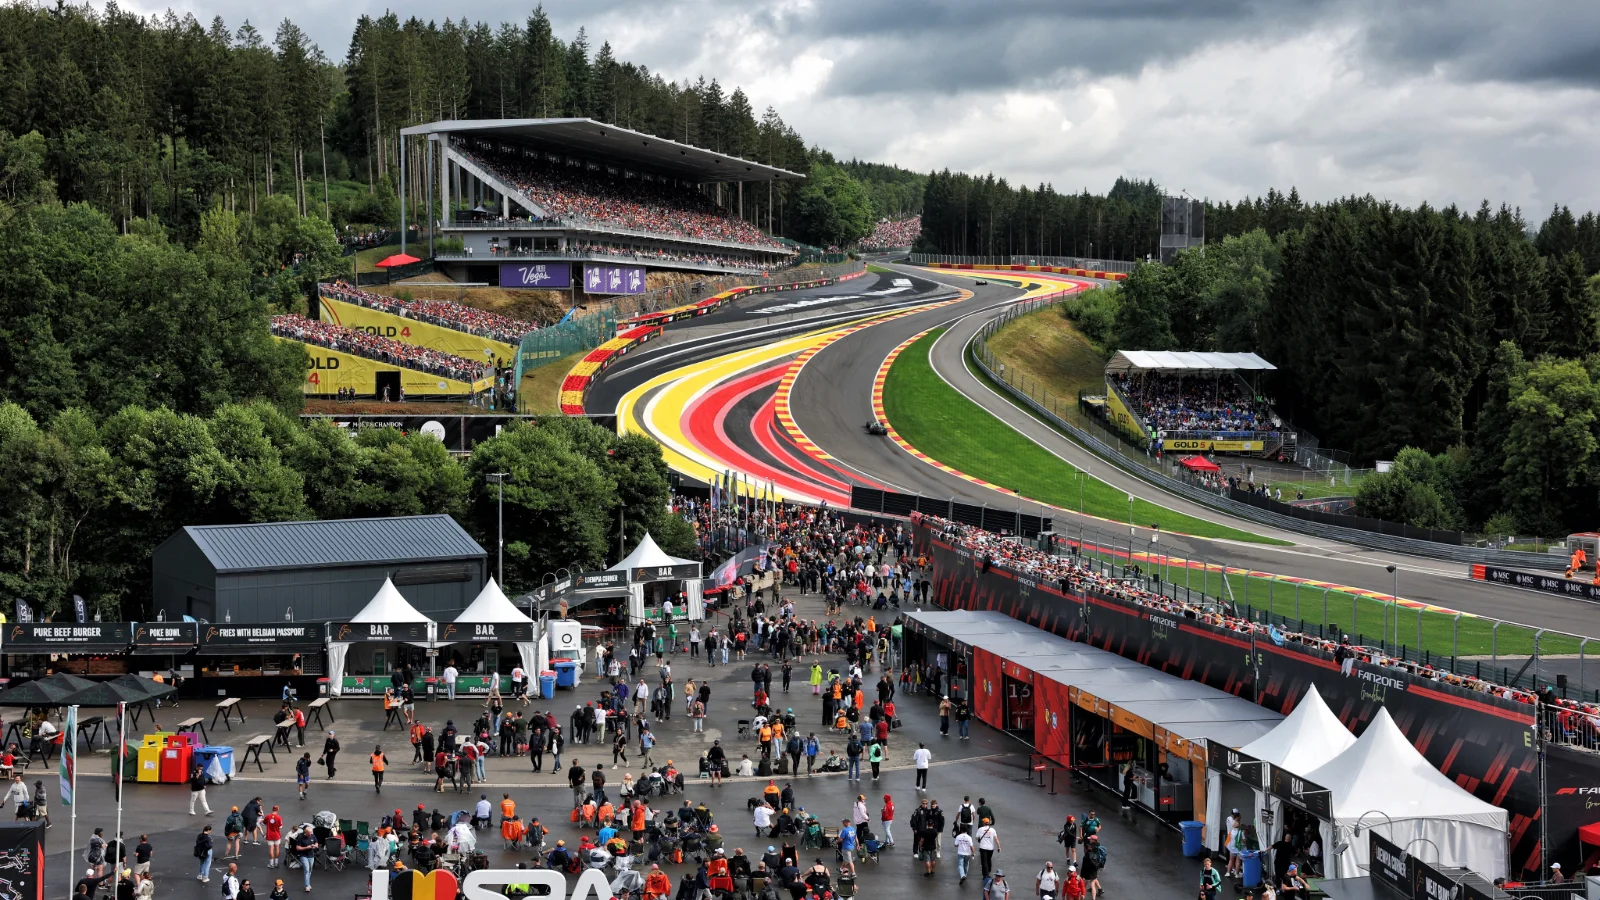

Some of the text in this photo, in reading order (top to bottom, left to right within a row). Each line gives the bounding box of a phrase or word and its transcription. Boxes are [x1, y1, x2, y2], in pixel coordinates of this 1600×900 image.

[518, 265, 551, 286] Vegas
[400, 326, 412, 338] 4
[307, 357, 340, 370] OLD
[308, 372, 320, 385] 4
[1173, 441, 1199, 449] GOLD
[1200, 441, 1206, 449] 5
[658, 567, 673, 576] BAR
[1497, 571, 1510, 580] MSC
[1522, 575, 1534, 584] MSC
[1546, 579, 1559, 588] MSC
[1570, 583, 1583, 592] MSC
[1149, 614, 1177, 629] FANZONE
[33, 627, 101, 637] PURE BEEF BURGER
[150, 628, 181, 637] POKE BOWL
[219, 627, 305, 637] FRIES WITH BELGIAN PASSPORT
[370, 624, 390, 636] BAR
[475, 624, 495, 636] BAR
[1245, 654, 1250, 666] F
[1257, 653, 1263, 665] E
[1358, 669, 1404, 691] FANZONE
[1523, 731, 1532, 748] E
[1291, 777, 1304, 800] BAR
